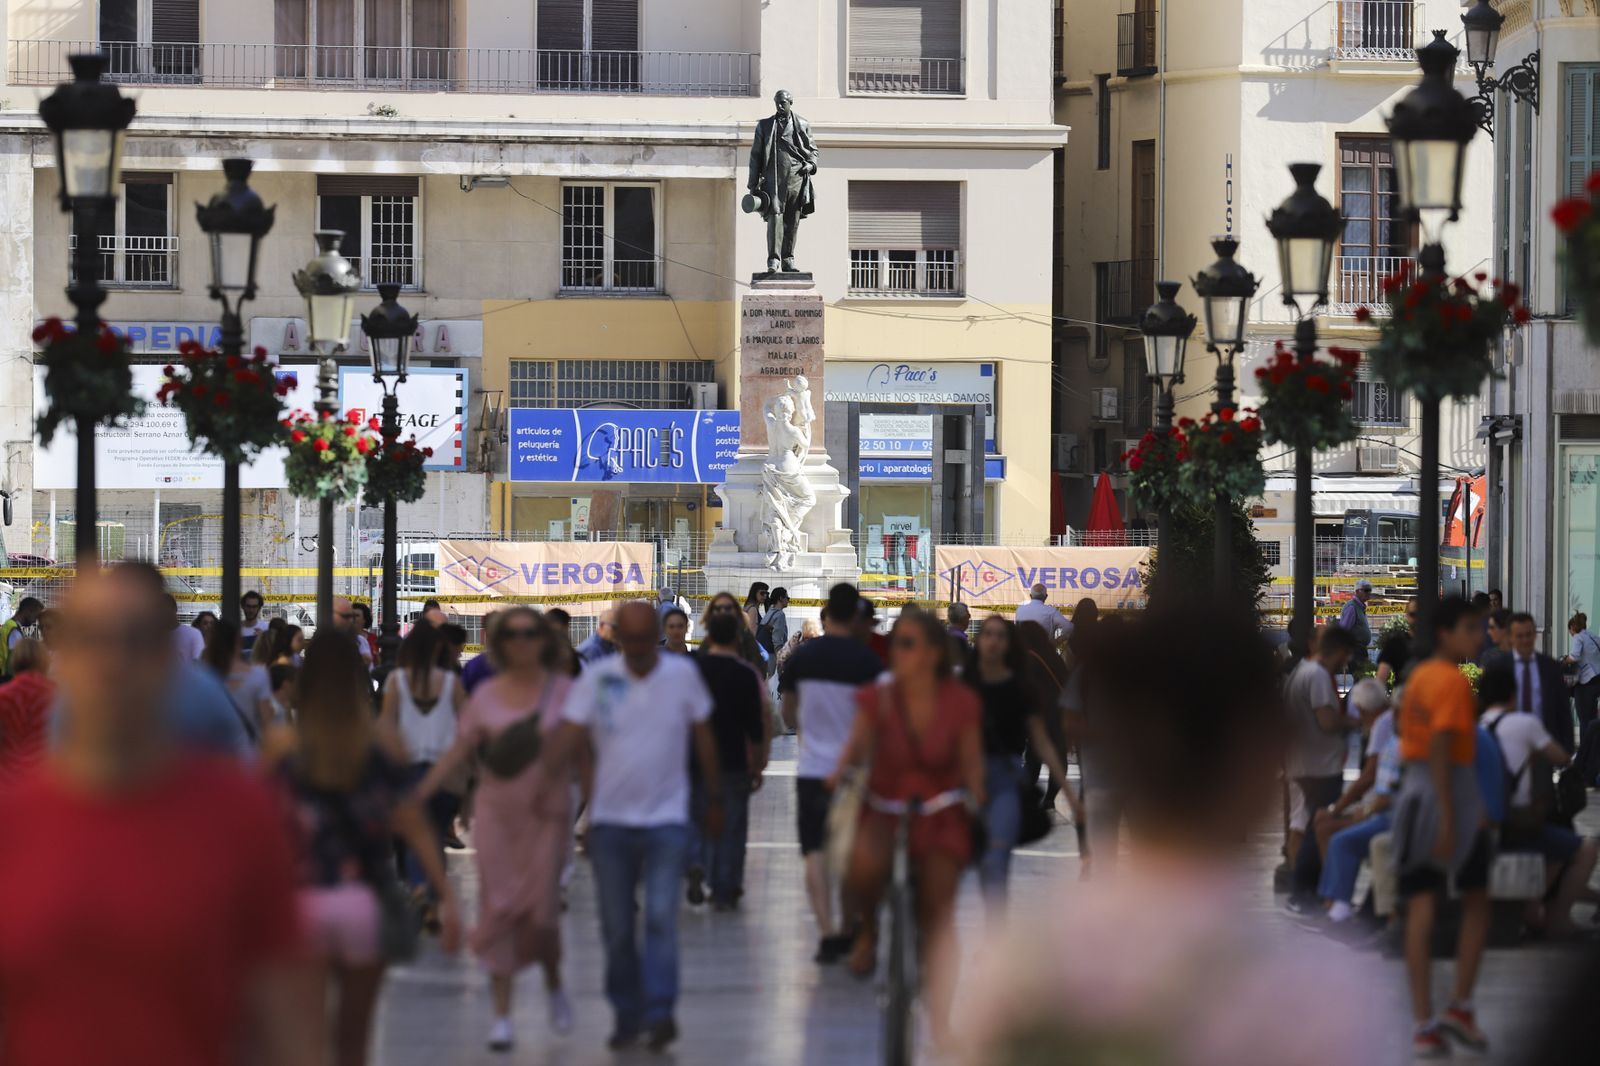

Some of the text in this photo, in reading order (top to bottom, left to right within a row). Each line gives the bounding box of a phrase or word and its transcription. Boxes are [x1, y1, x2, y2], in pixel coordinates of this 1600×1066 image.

[743, 309, 822, 317] A DON MANUEL DOMINGO
[770, 320, 796, 329] LARIOS
[753, 336, 783, 344] MARQUES
[786, 336, 794, 344] DE
[797, 336, 820, 344] LARIOS
[768, 352, 797, 360] MALAGA
[760, 366, 805, 375] AGRADECIDA
[894, 392, 916, 402] NOS
[919, 393, 991, 403] TRASLADAMOS
[134, 430, 161, 438] Serrano
[163, 430, 183, 438] Aznar
[516, 427, 562, 435] artículos de
[518, 440, 560, 450] peluquería
[873, 440, 885, 450] 50
[889, 440, 901, 450] 10
[519, 452, 558, 463] y estética
[890, 522, 912, 531] nirvel
[520, 562, 645, 584] VEROSA
[1017, 566, 1142, 590] VEROSA
